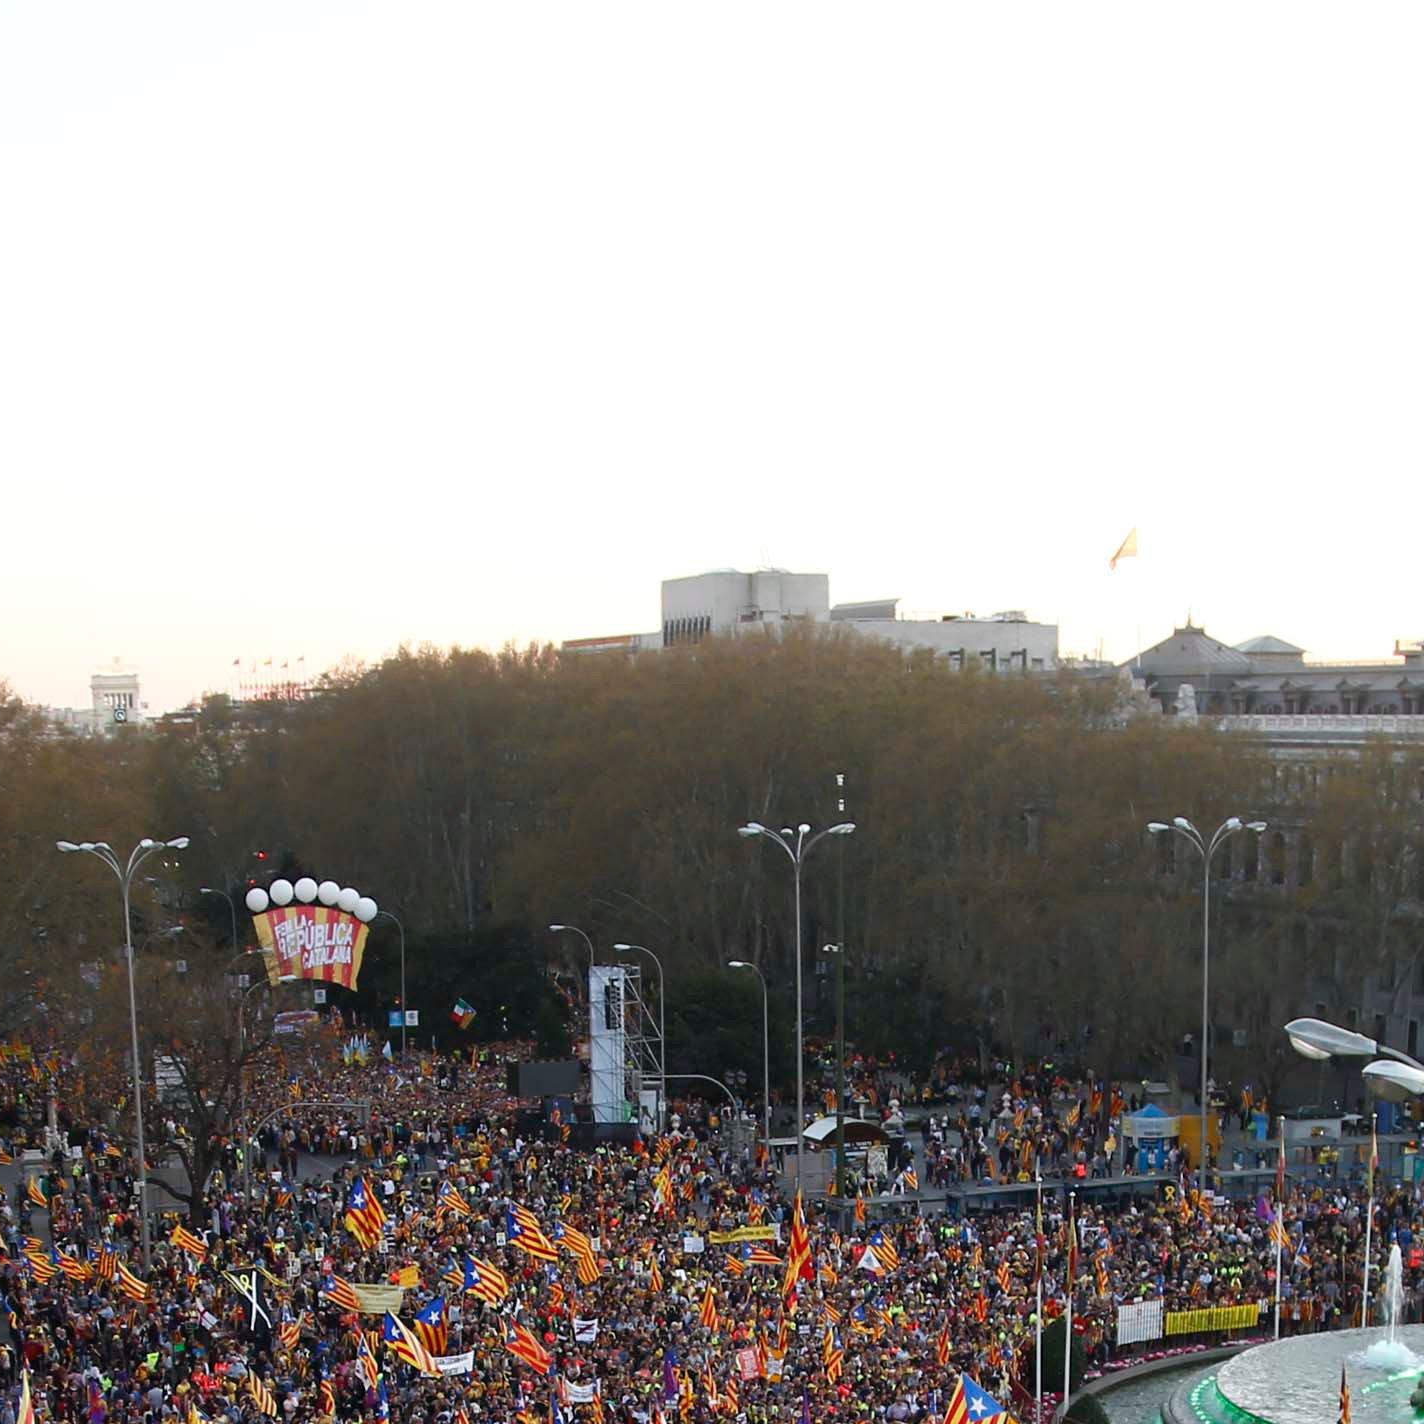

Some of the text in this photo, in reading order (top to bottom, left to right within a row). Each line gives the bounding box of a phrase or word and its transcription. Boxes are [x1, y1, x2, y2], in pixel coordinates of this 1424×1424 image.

[295, 914, 307, 930] LA
[278, 920, 354, 961] REPÚBLICA
[302, 946, 352, 970] CATALANA
